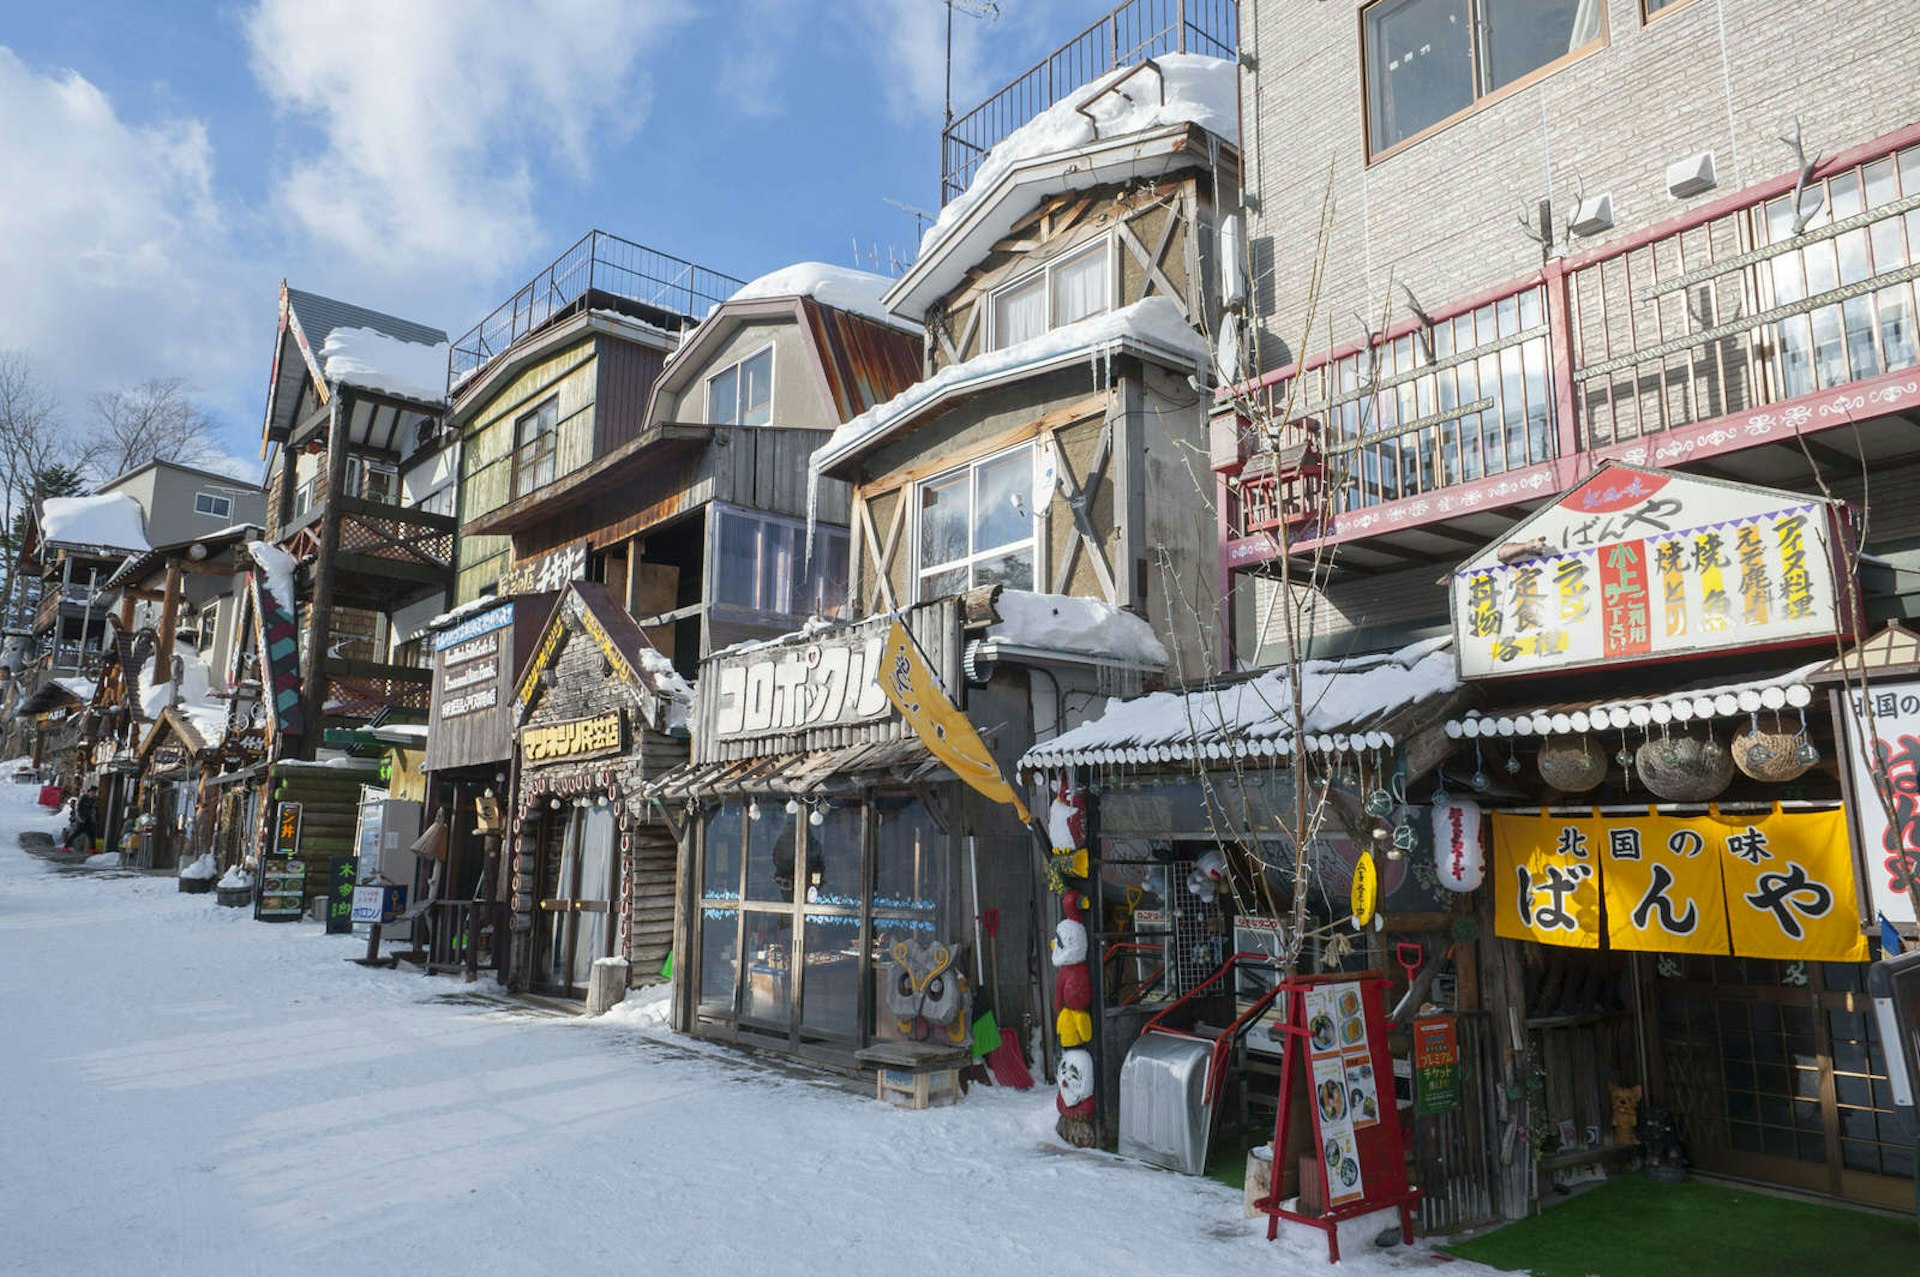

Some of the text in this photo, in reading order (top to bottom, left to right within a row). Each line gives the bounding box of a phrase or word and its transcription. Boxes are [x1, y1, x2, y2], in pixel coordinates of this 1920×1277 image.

[1562, 499, 1683, 549] ばんや
[1508, 567, 1548, 633] 定食
[1772, 514, 1817, 621] アイヌ料理
[1556, 826, 1774, 864] 北国の味
[1516, 861, 1835, 941] ばんや
